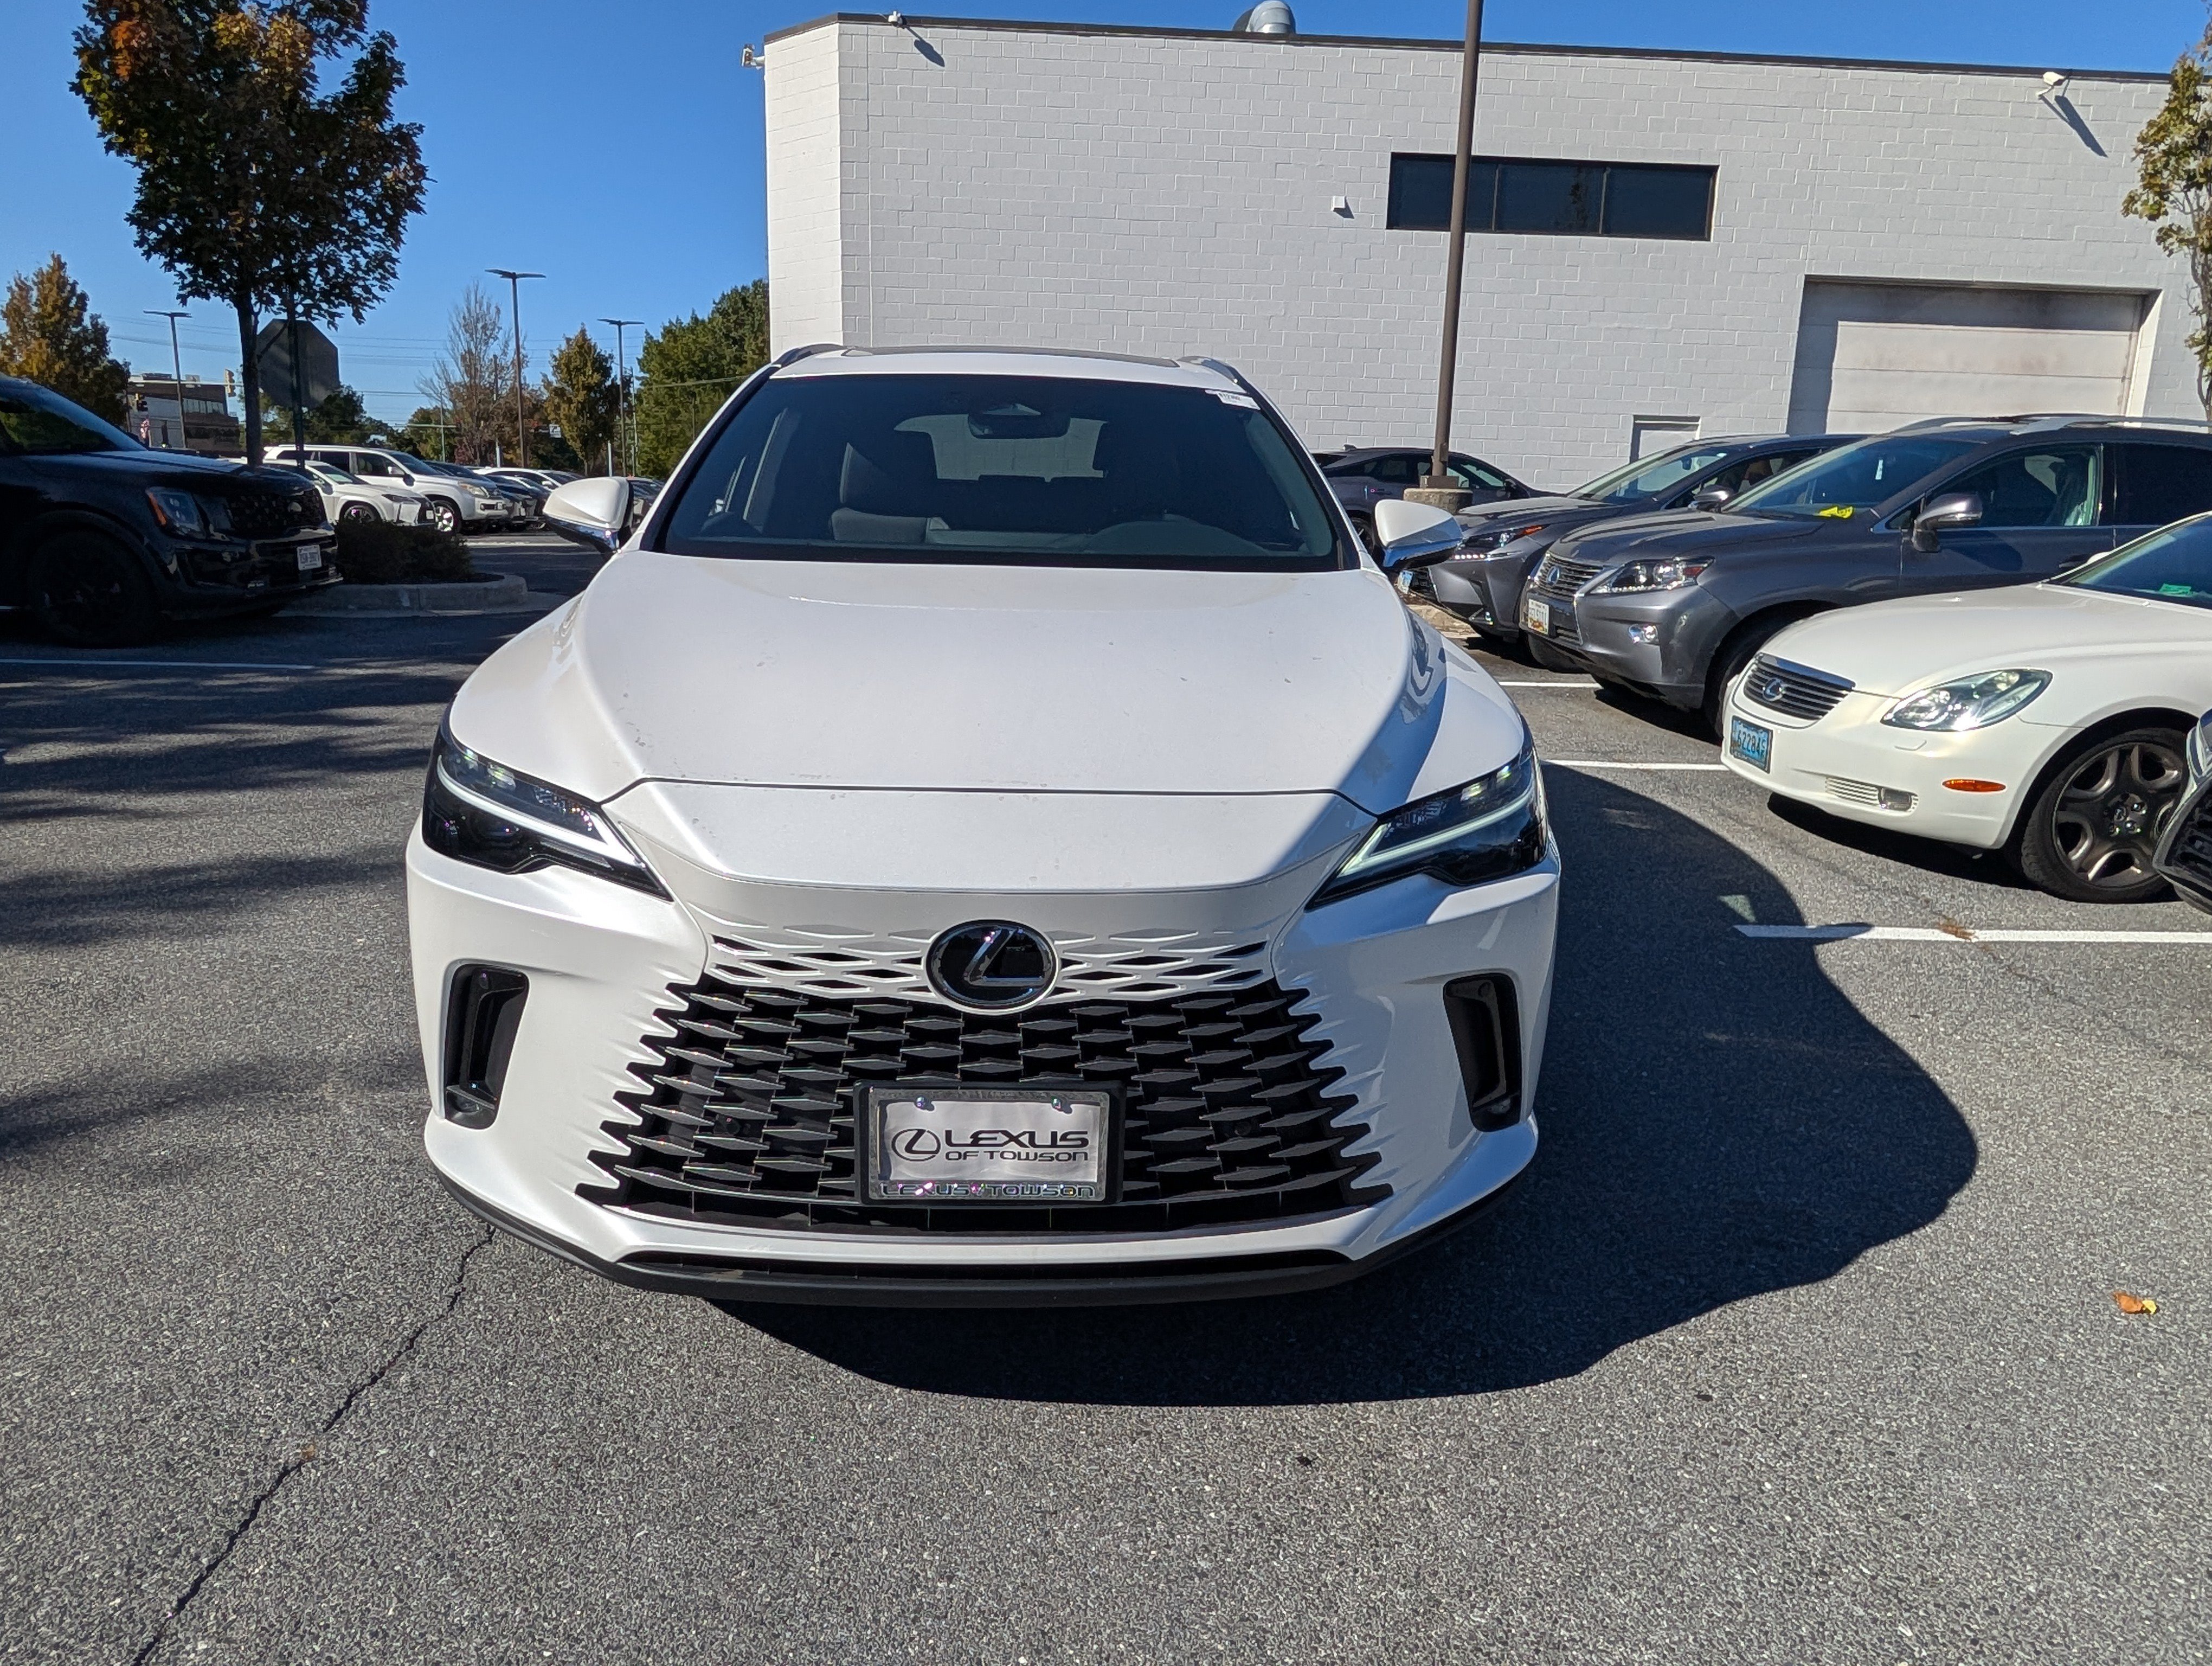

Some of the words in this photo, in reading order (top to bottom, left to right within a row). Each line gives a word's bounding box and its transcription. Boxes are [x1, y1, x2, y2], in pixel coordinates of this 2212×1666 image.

[945, 1130, 1089, 1148] LEXUS
[945, 1150, 979, 1161] OF
[984, 1150, 1089, 1162] TOWSON
[985, 1184, 1095, 1197] TOWSON
